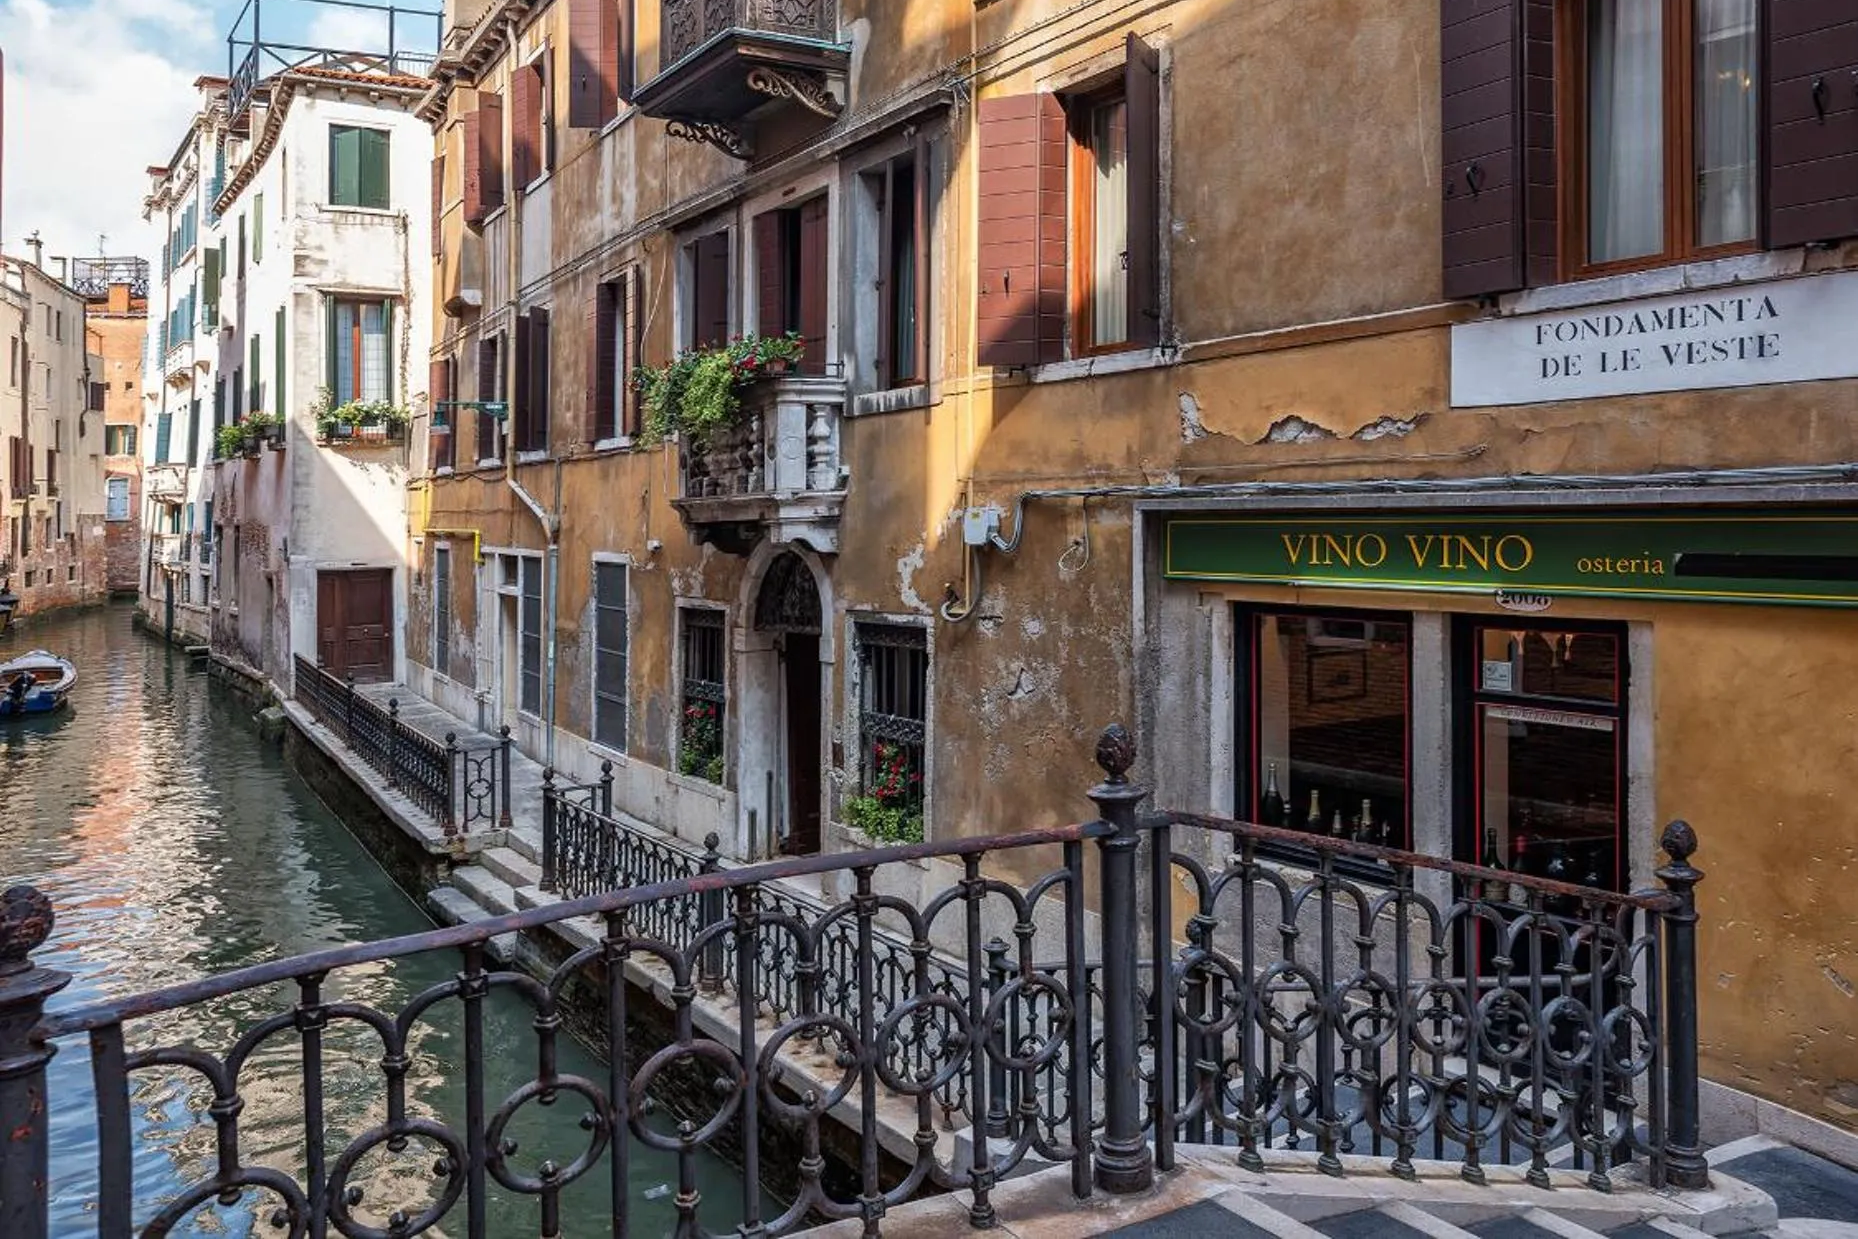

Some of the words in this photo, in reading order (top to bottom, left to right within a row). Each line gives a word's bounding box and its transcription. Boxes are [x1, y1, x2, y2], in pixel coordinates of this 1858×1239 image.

[1535, 295, 1779, 345] FONDAMENTA
[1541, 353, 1583, 379] DE
[1600, 348, 1641, 373] LE
[1661, 333, 1781, 366] VESTE
[1281, 533, 1387, 567] VINO
[1405, 534, 1534, 572] VINO
[1576, 551, 1665, 575] osteria
